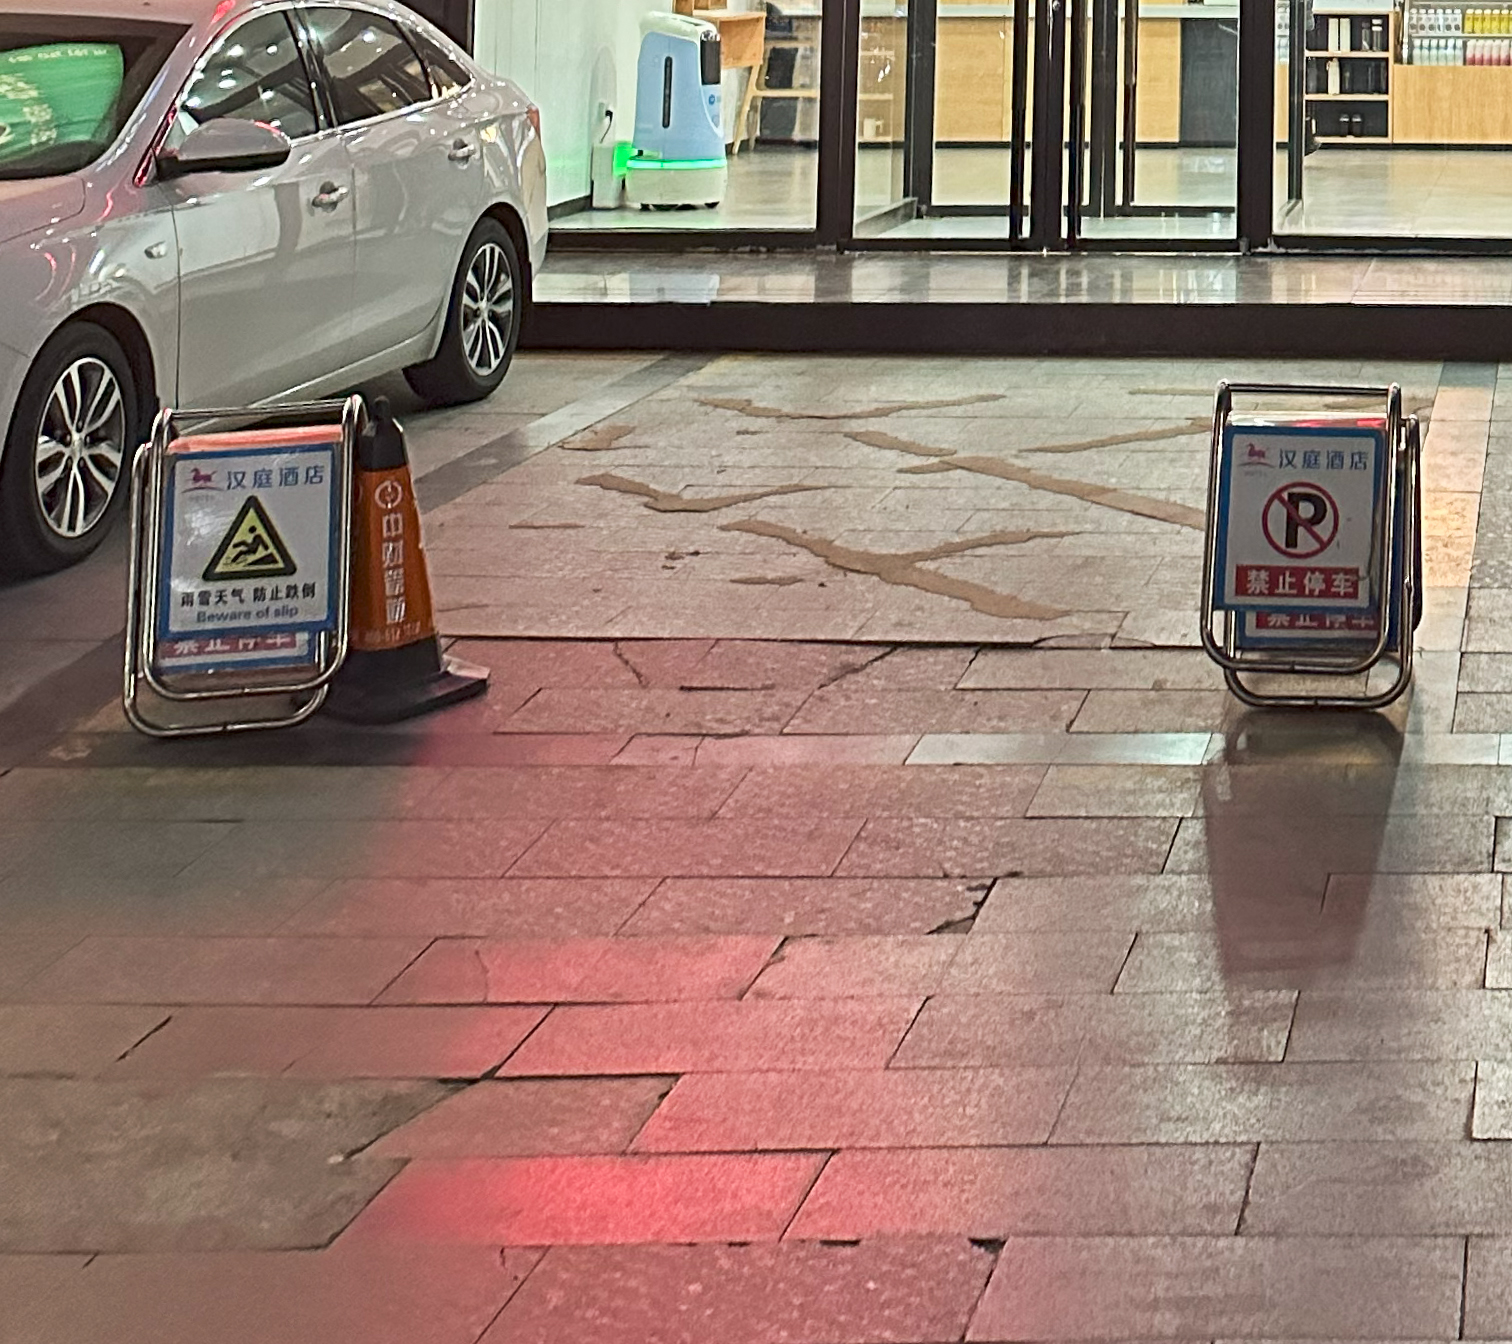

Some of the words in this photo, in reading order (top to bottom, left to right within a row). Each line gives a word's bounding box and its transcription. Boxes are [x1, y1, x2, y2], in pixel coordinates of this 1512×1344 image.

[1279, 448, 1369, 470] 汉庭酒店
[227, 465, 325, 490] 汉庭酒店
[181, 588, 245, 608] 雨雪天气
[252, 582, 316, 603] 防止跌倒
[1246, 569, 1354, 596] 禁止停车
[196, 609, 250, 623] Beware
[256, 607, 270, 619] of
[274, 605, 299, 619] slip
